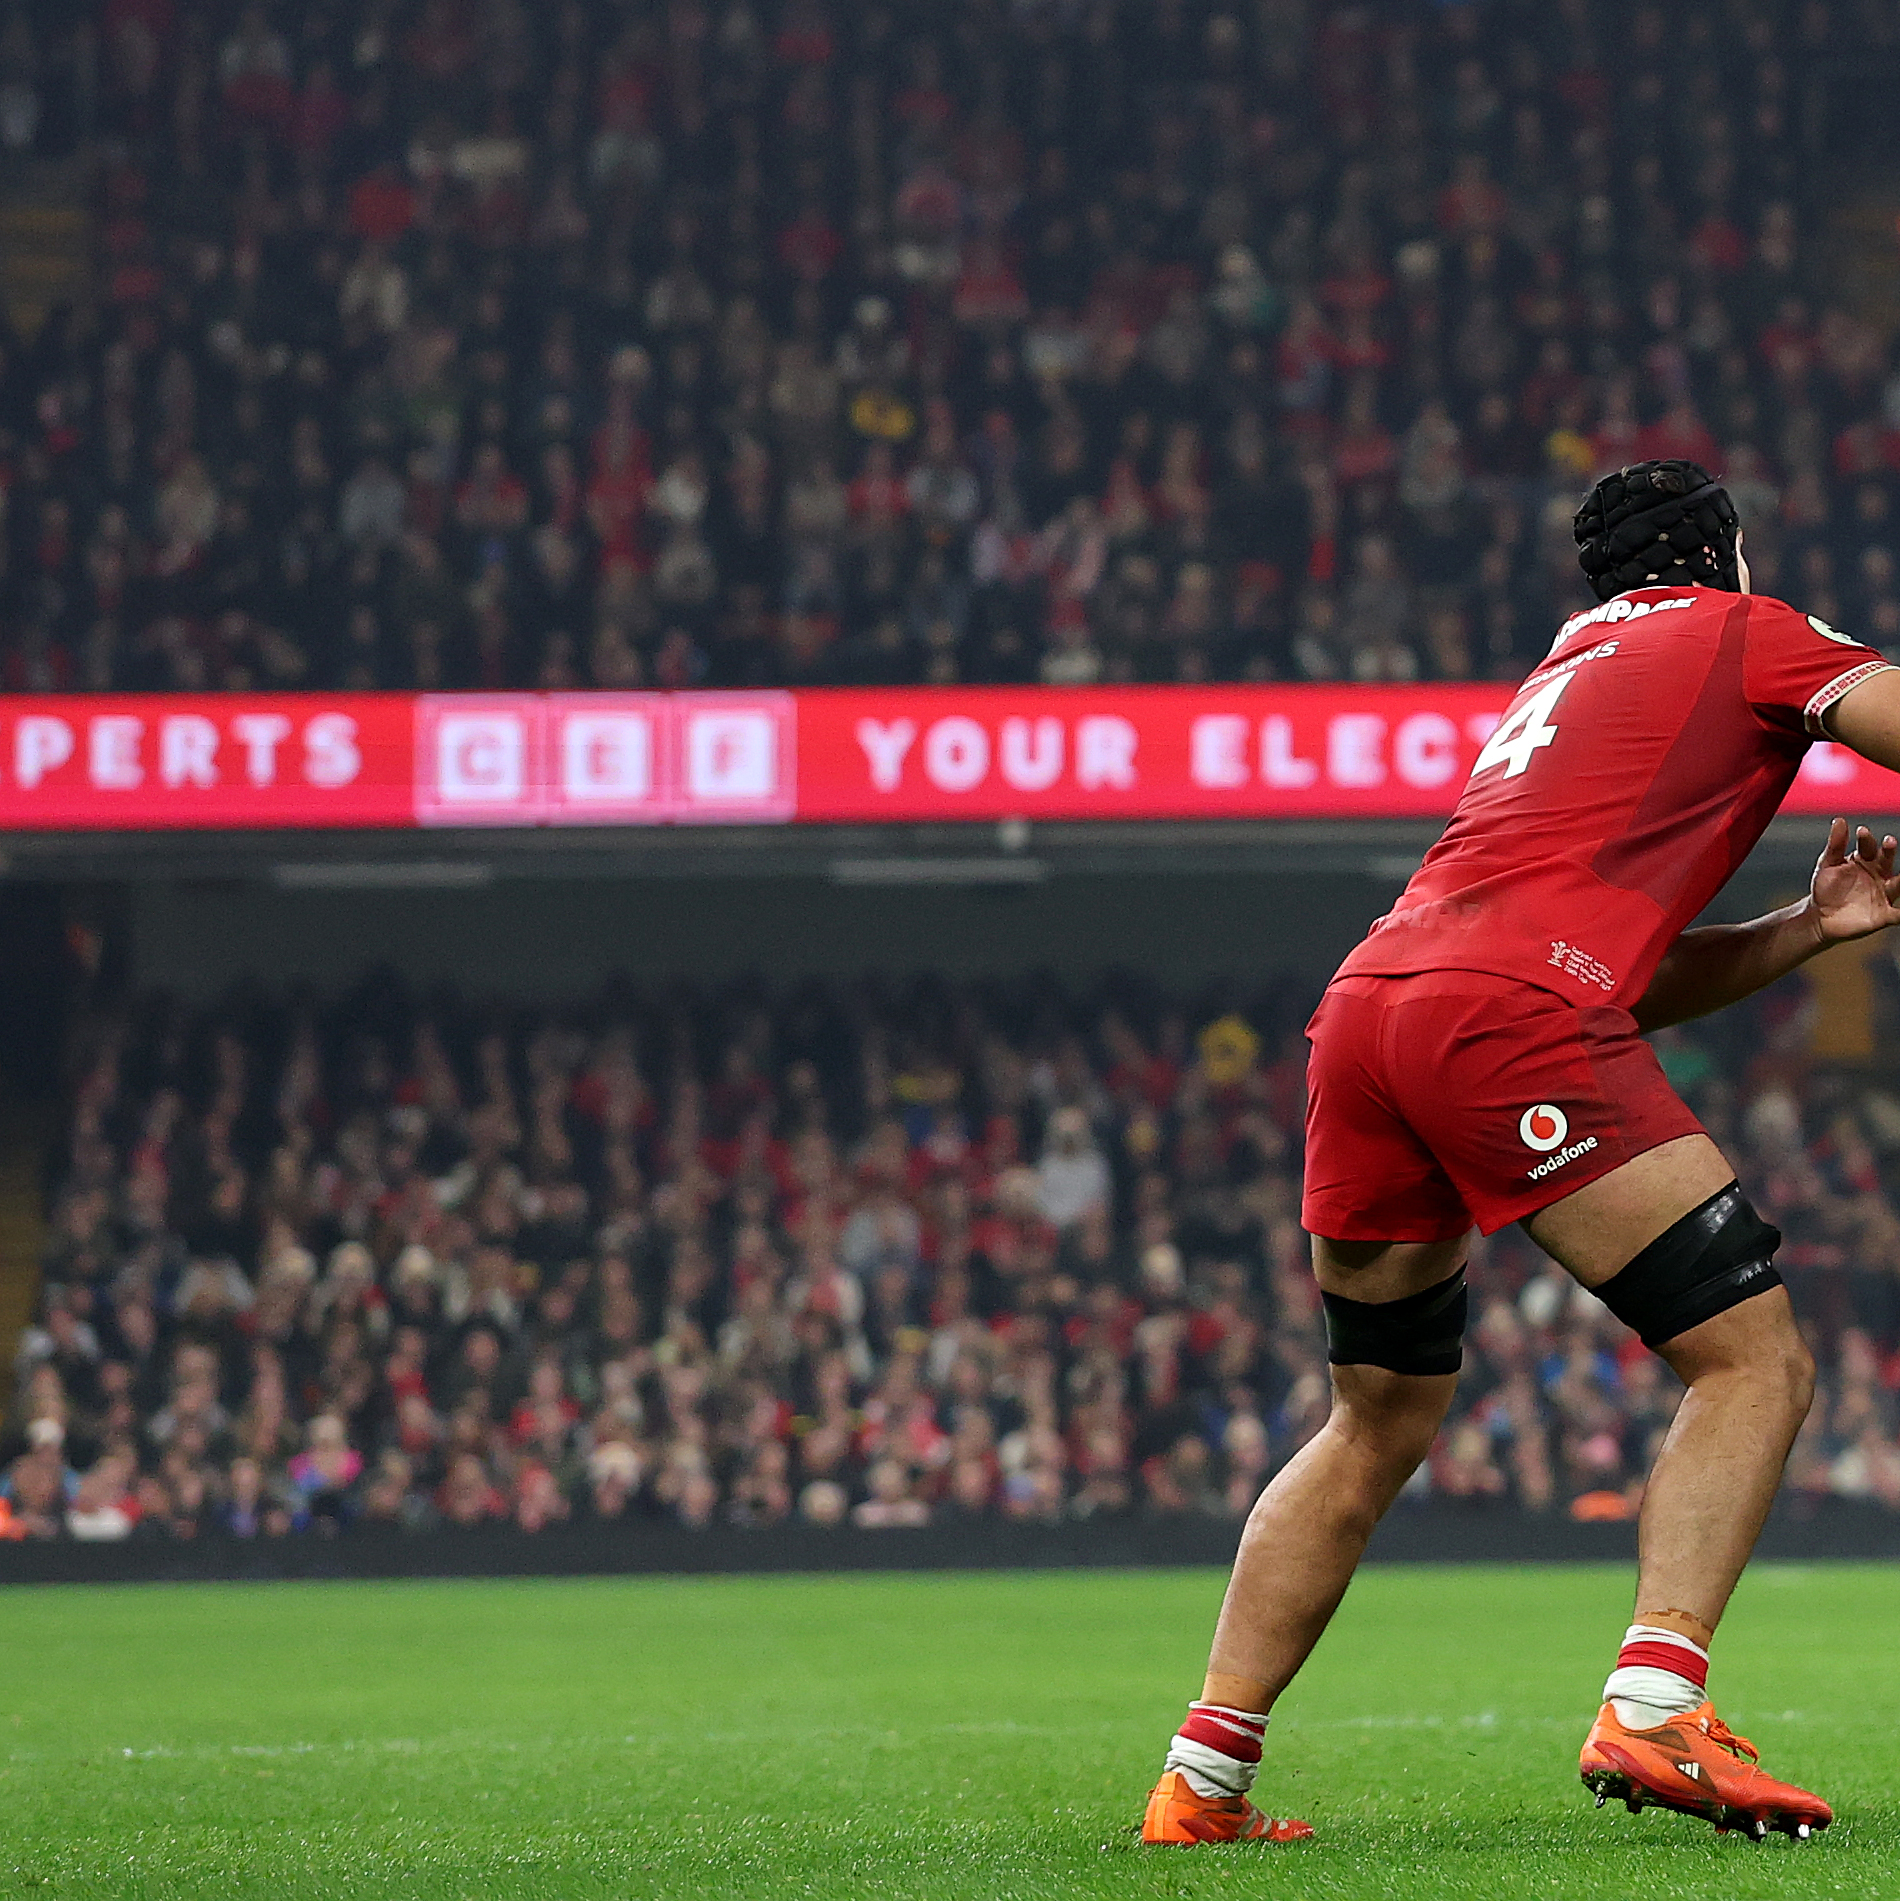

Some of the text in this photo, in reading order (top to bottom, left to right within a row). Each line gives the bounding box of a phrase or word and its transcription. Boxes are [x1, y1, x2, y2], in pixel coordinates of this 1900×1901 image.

[855, 713, 1142, 793] YOUR
[1470, 669, 1578, 781] 4
[1528, 1134, 1598, 1182] vodafone
